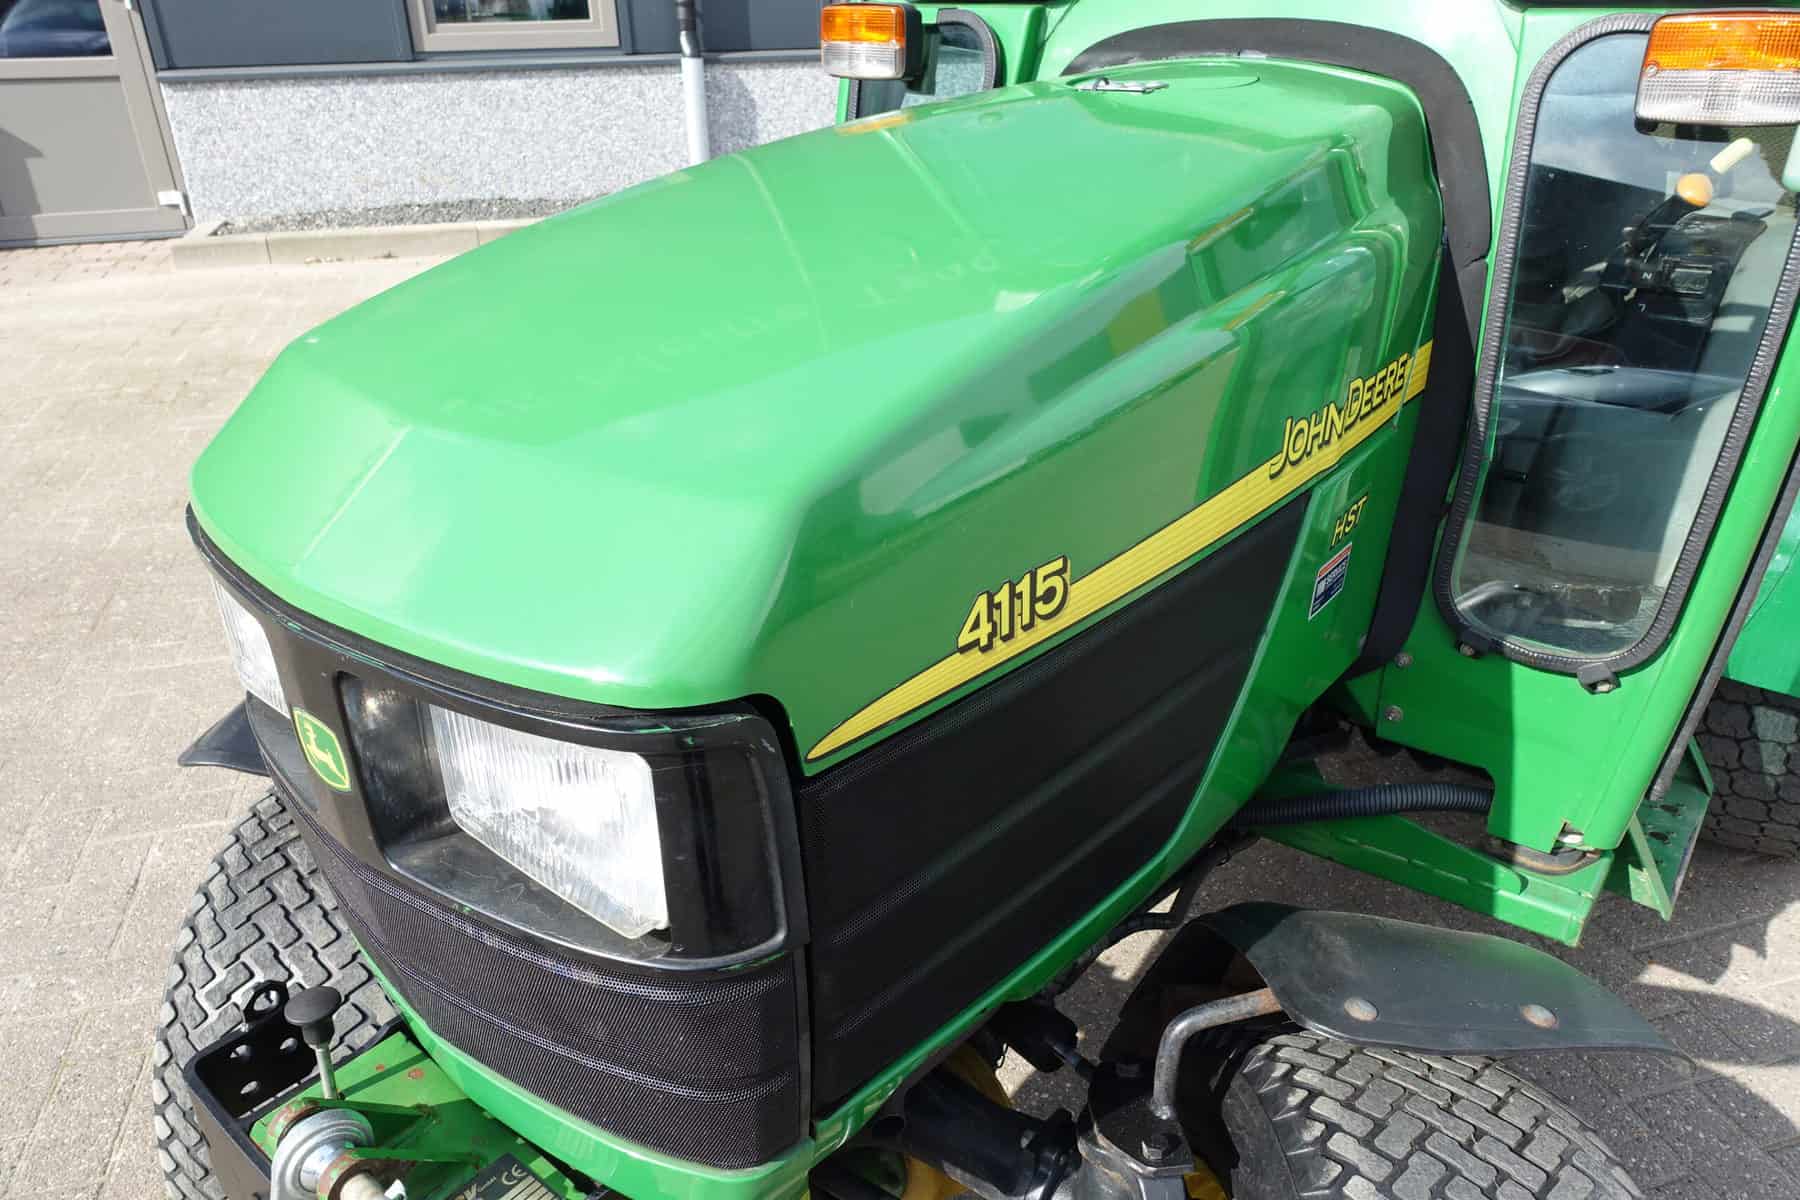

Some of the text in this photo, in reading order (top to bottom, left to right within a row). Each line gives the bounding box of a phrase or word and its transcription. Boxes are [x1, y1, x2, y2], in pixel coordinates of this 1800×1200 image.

[1269, 353, 1412, 479] JOHN DEERE
[1330, 494, 1369, 550] HST
[956, 554, 1069, 655] 4115
